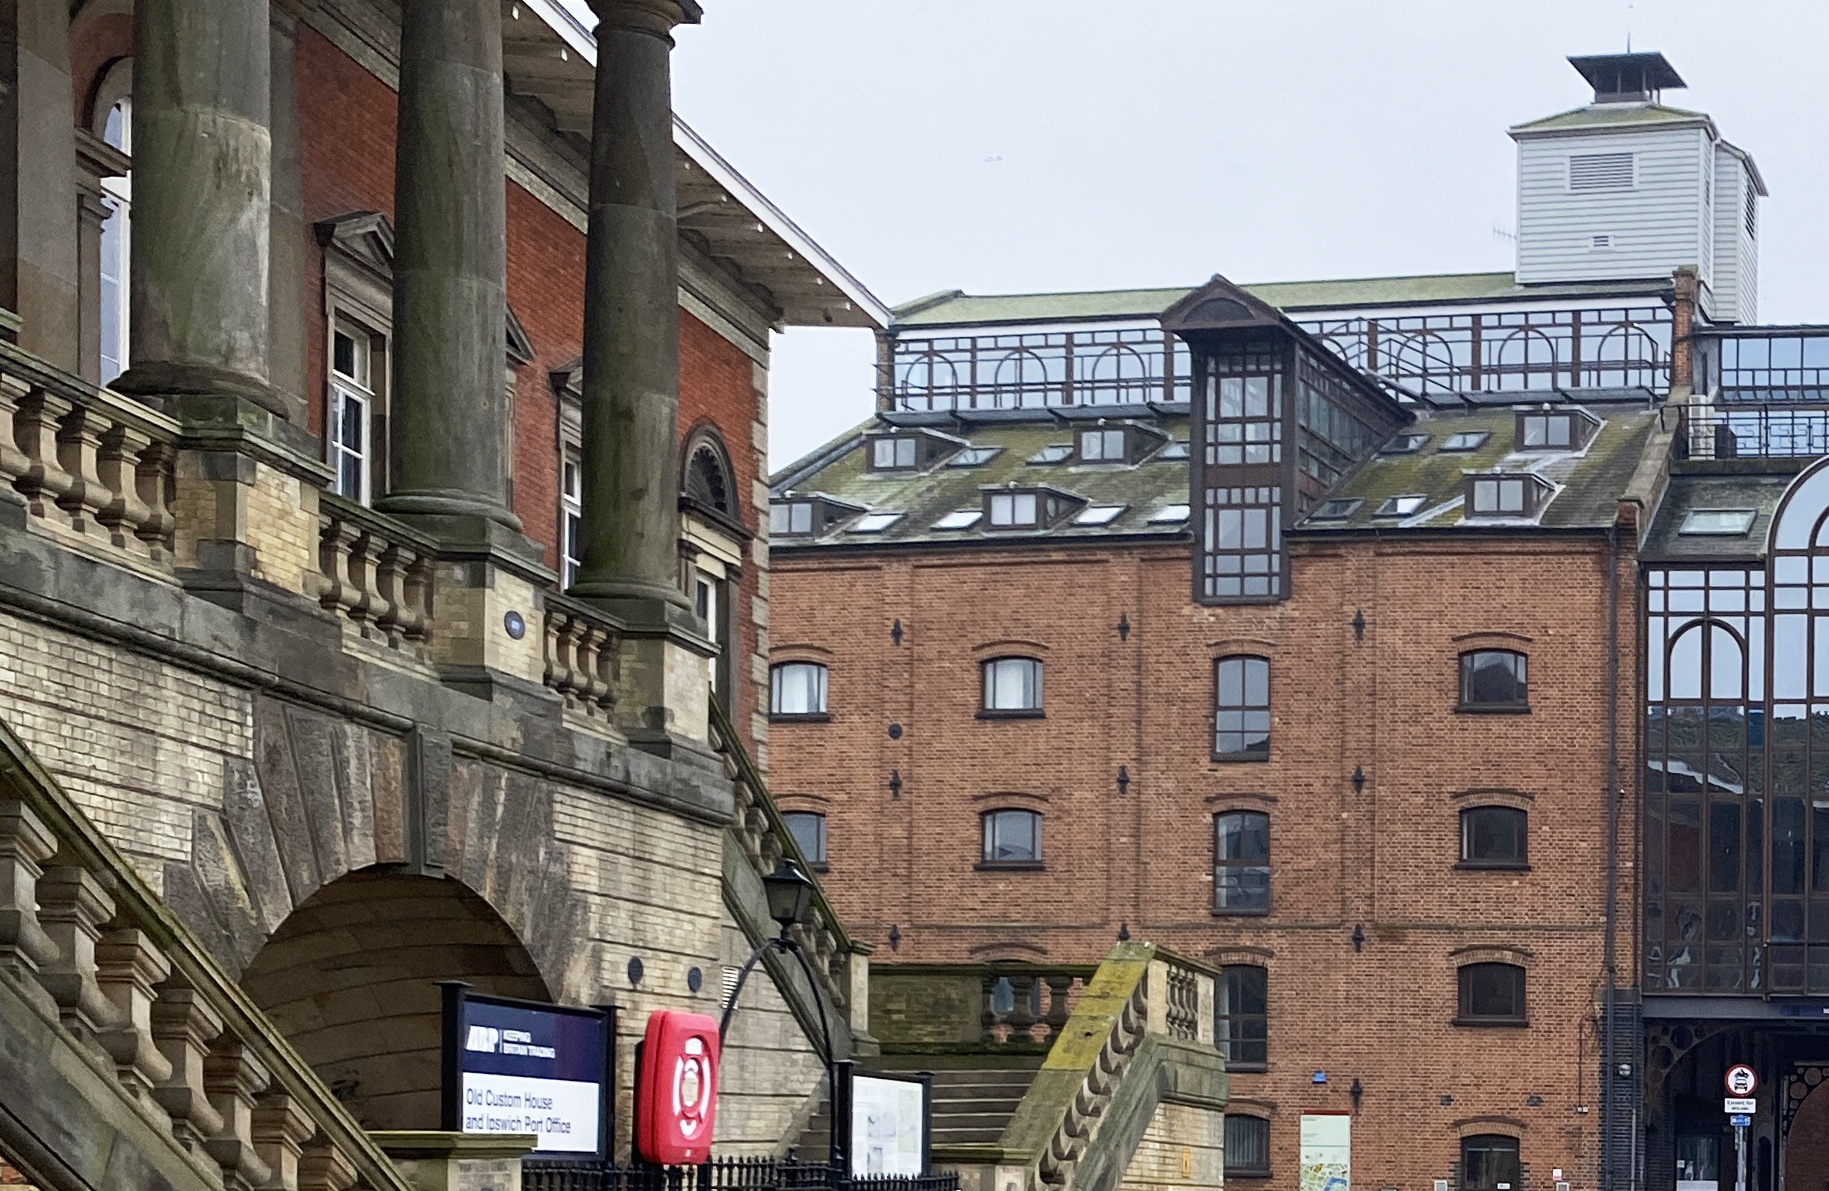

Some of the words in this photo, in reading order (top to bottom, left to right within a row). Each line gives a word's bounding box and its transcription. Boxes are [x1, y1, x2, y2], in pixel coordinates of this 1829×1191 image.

[466, 1088, 483, 1106] Old
[486, 1089, 521, 1108] Custom
[524, 1092, 553, 1110] House
[466, 1113, 483, 1130] and
[486, 1113, 522, 1134] Ipswich
[525, 1115, 543, 1132] Port
[545, 1117, 571, 1134] Office
